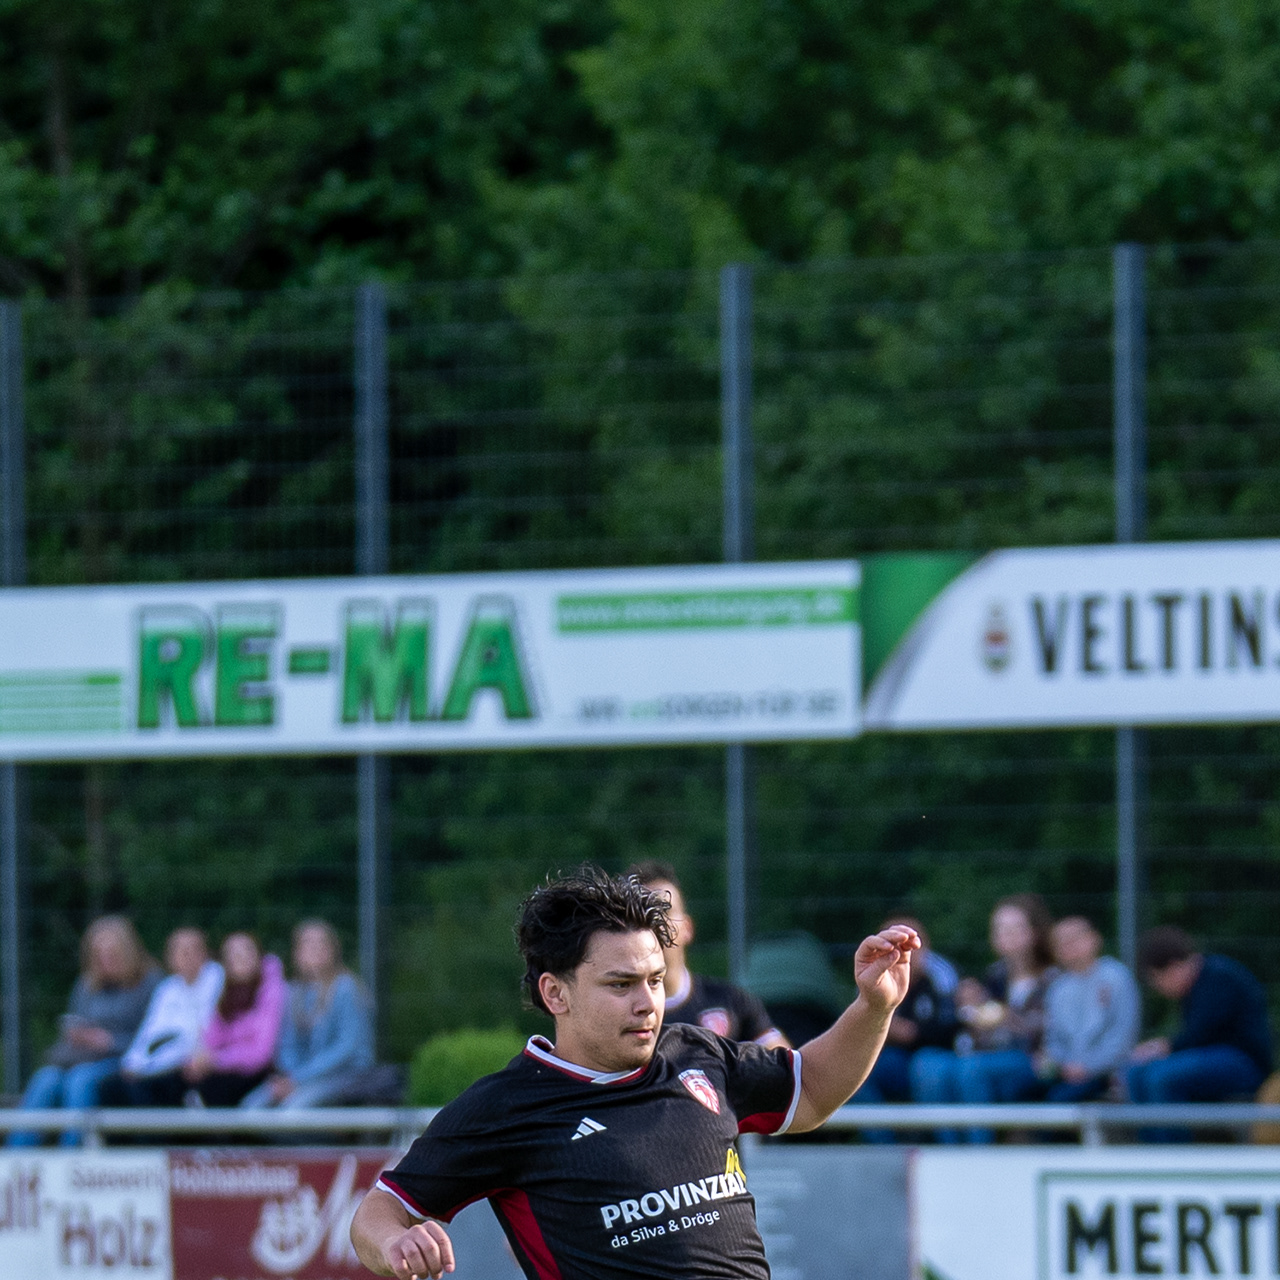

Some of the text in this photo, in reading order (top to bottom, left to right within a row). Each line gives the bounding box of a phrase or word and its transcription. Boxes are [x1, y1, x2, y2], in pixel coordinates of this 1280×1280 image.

[134, 598, 543, 731] RE-MA
[601, 1171, 747, 1229] PROVINZIAL
[611, 1209, 721, 1248] da Silva & Dröge
[59, 1201, 160, 1269] Holz
